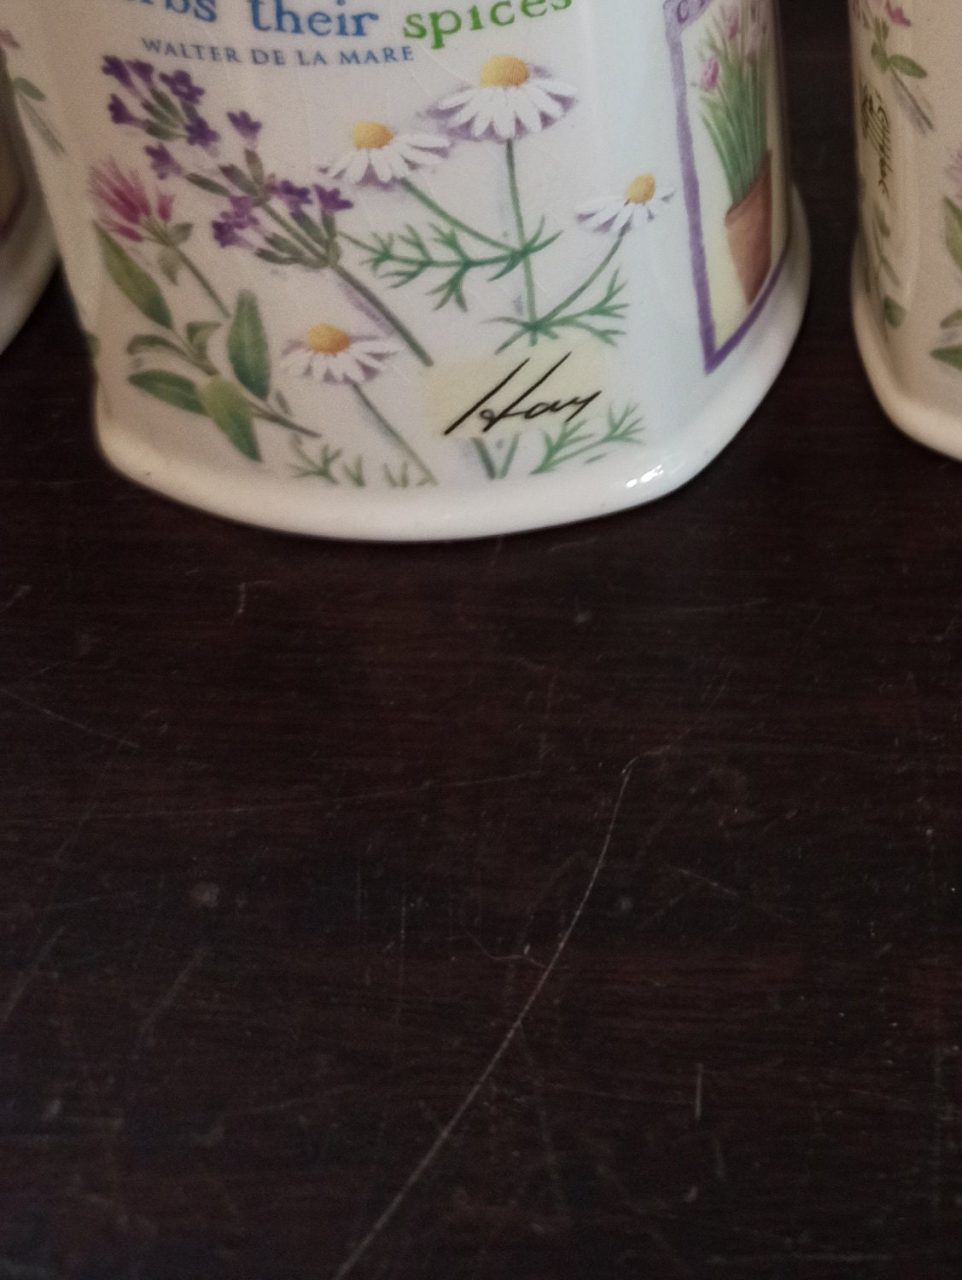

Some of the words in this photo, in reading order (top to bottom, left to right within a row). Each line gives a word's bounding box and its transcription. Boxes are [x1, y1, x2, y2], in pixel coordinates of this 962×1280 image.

[142, 37, 241, 63] WALTER
[250, 48, 286, 66] DE
[298, 49, 328, 66] LA
[338, 46, 415, 65] MARE
